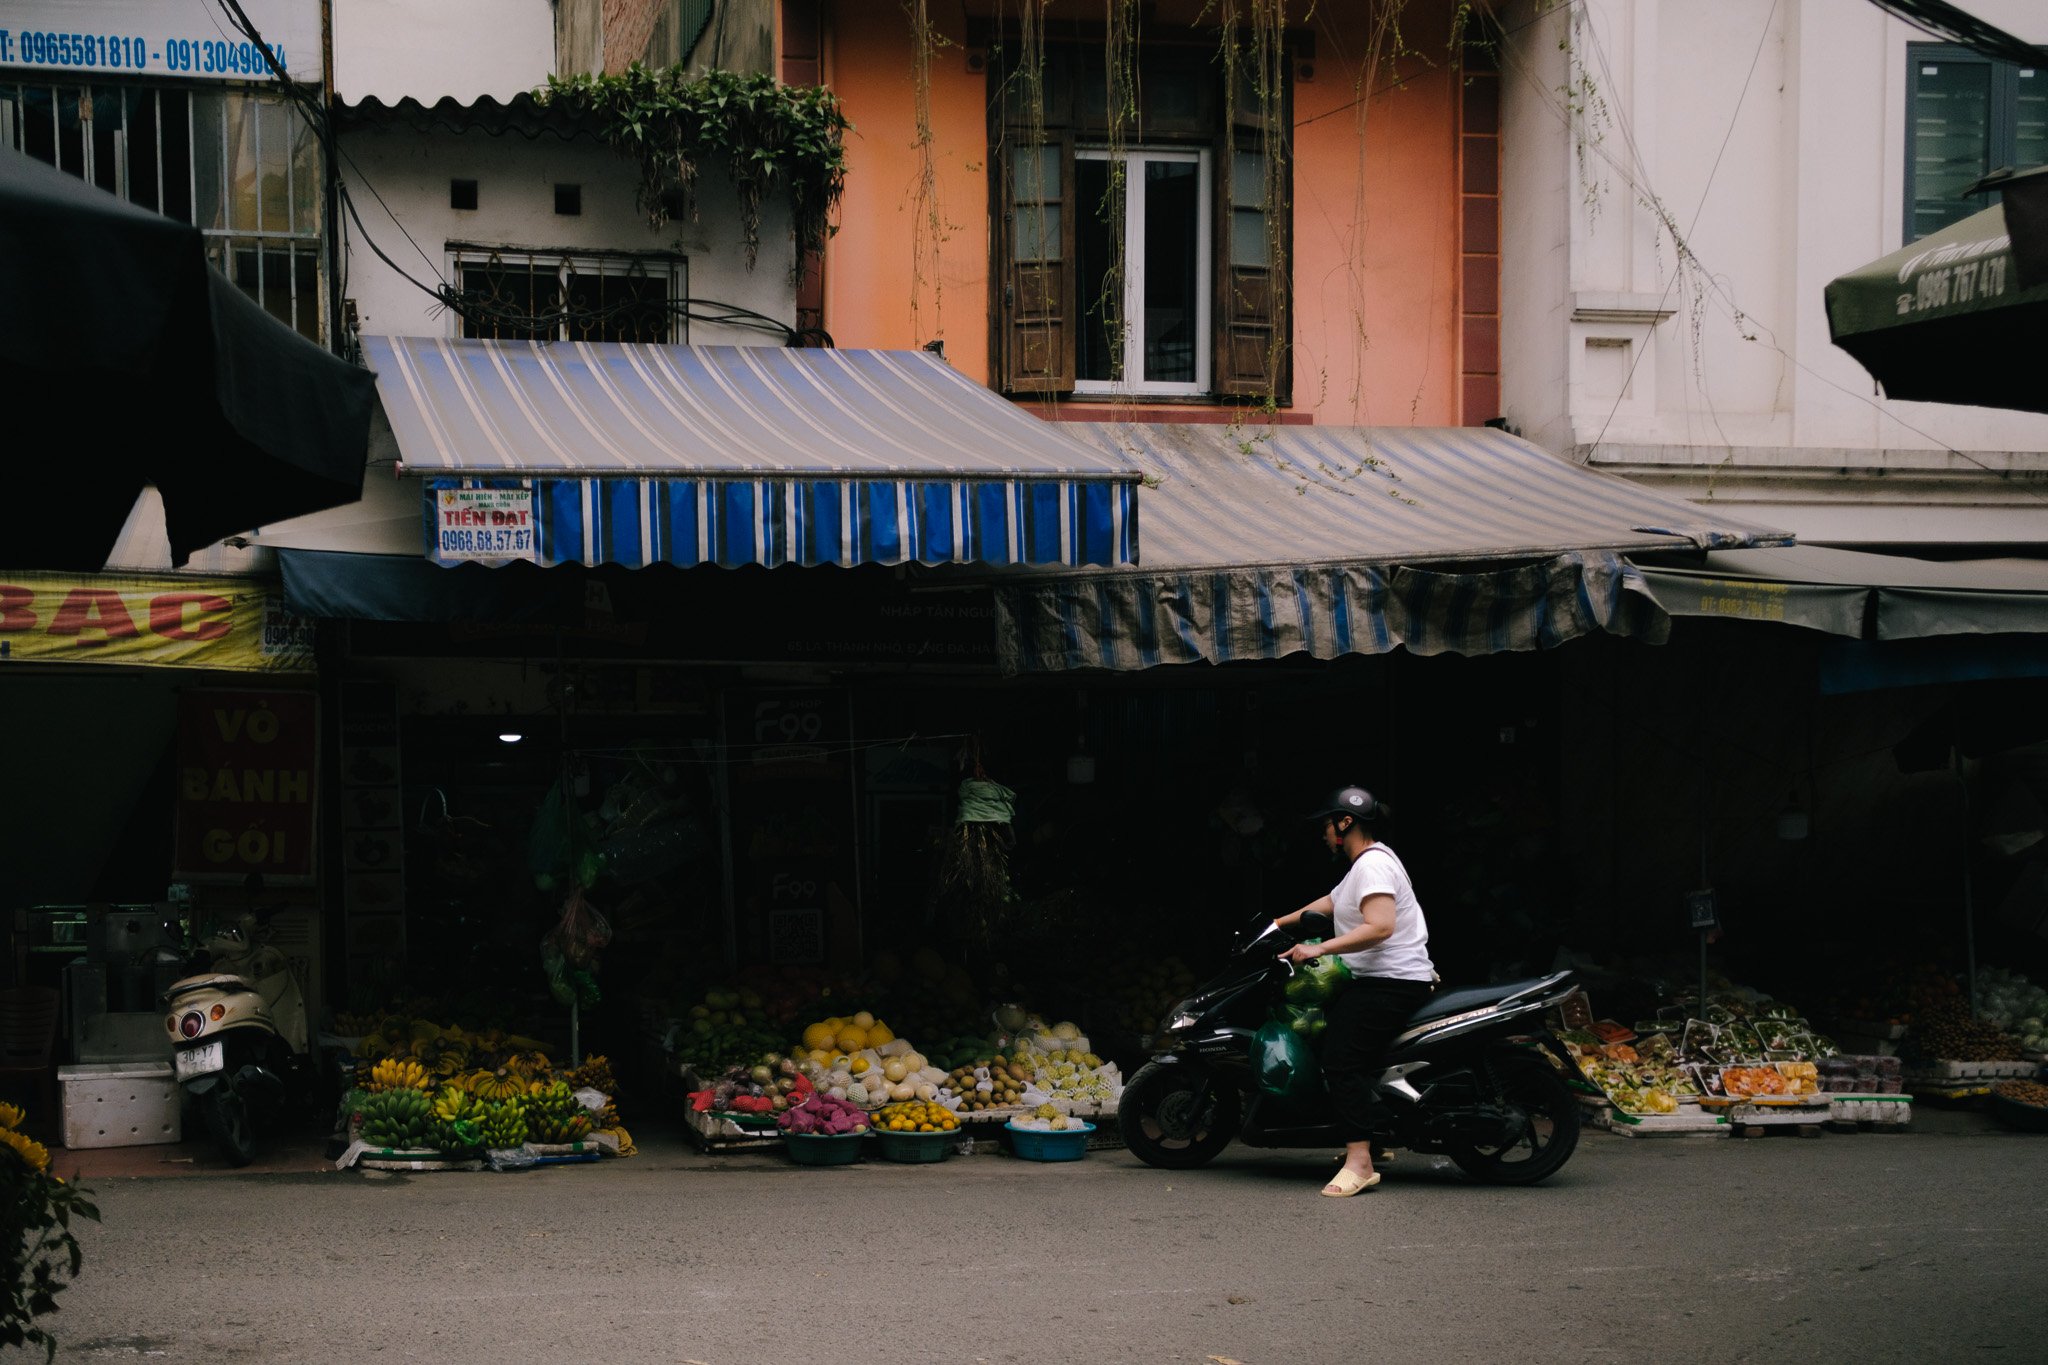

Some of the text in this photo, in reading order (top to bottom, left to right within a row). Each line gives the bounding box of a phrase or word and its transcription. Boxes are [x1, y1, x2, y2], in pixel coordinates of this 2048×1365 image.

[20, 31, 146, 68] 0965581810
[444, 506, 528, 528] TIẾN ĐẠT
[213, 700, 280, 744] VỎ
[755, 700, 822, 743] F99
[182, 760, 309, 803] BÁNH
[203, 818, 286, 864] GỐI
[772, 872, 817, 899] F99
